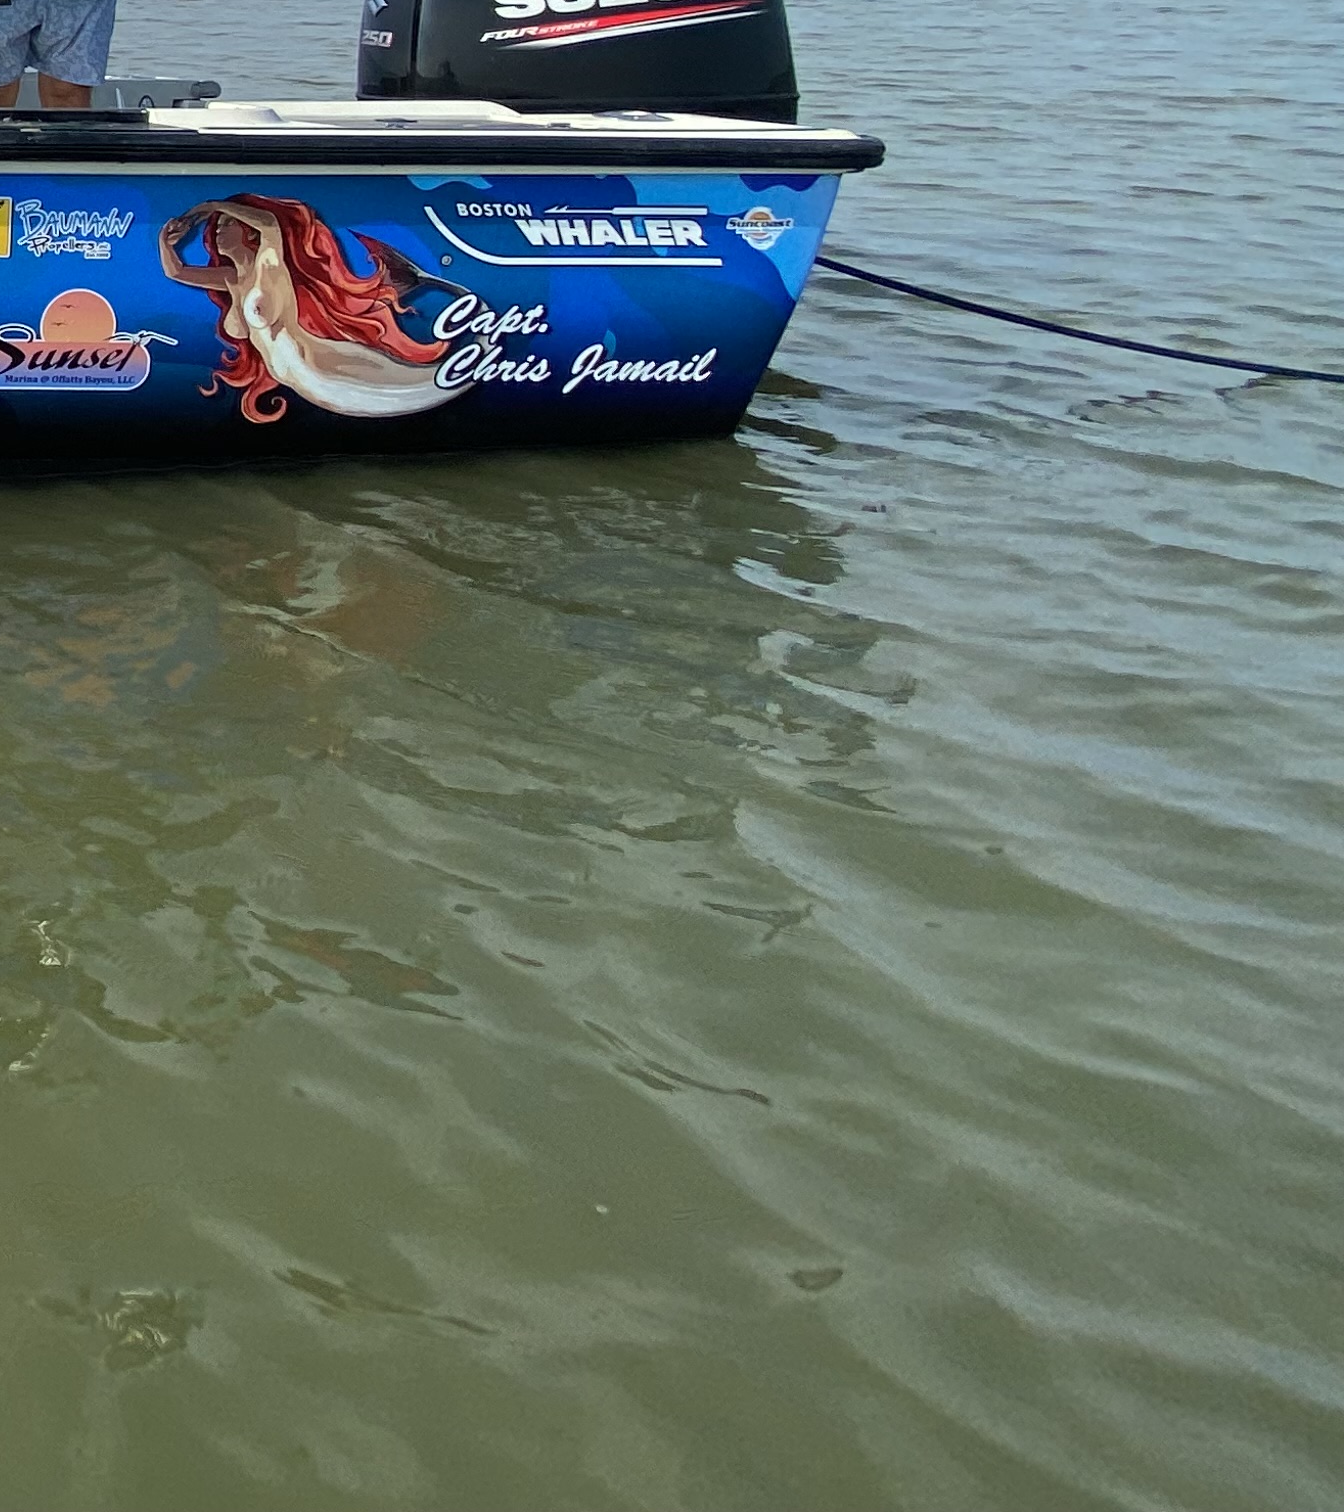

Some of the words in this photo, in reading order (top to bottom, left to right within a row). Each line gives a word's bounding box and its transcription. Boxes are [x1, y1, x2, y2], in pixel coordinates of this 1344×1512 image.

[362, 29, 393, 48] 250
[16, 199, 134, 245] BAUMANN
[456, 203, 532, 217] BOSTON
[515, 219, 709, 247] WHALER
[433, 294, 549, 343] Capt.
[5, 375, 38, 384] Marina
[117, 376, 135, 384] LLC
[435, 343, 552, 388] Chris
[562, 343, 717, 395] Jamail
